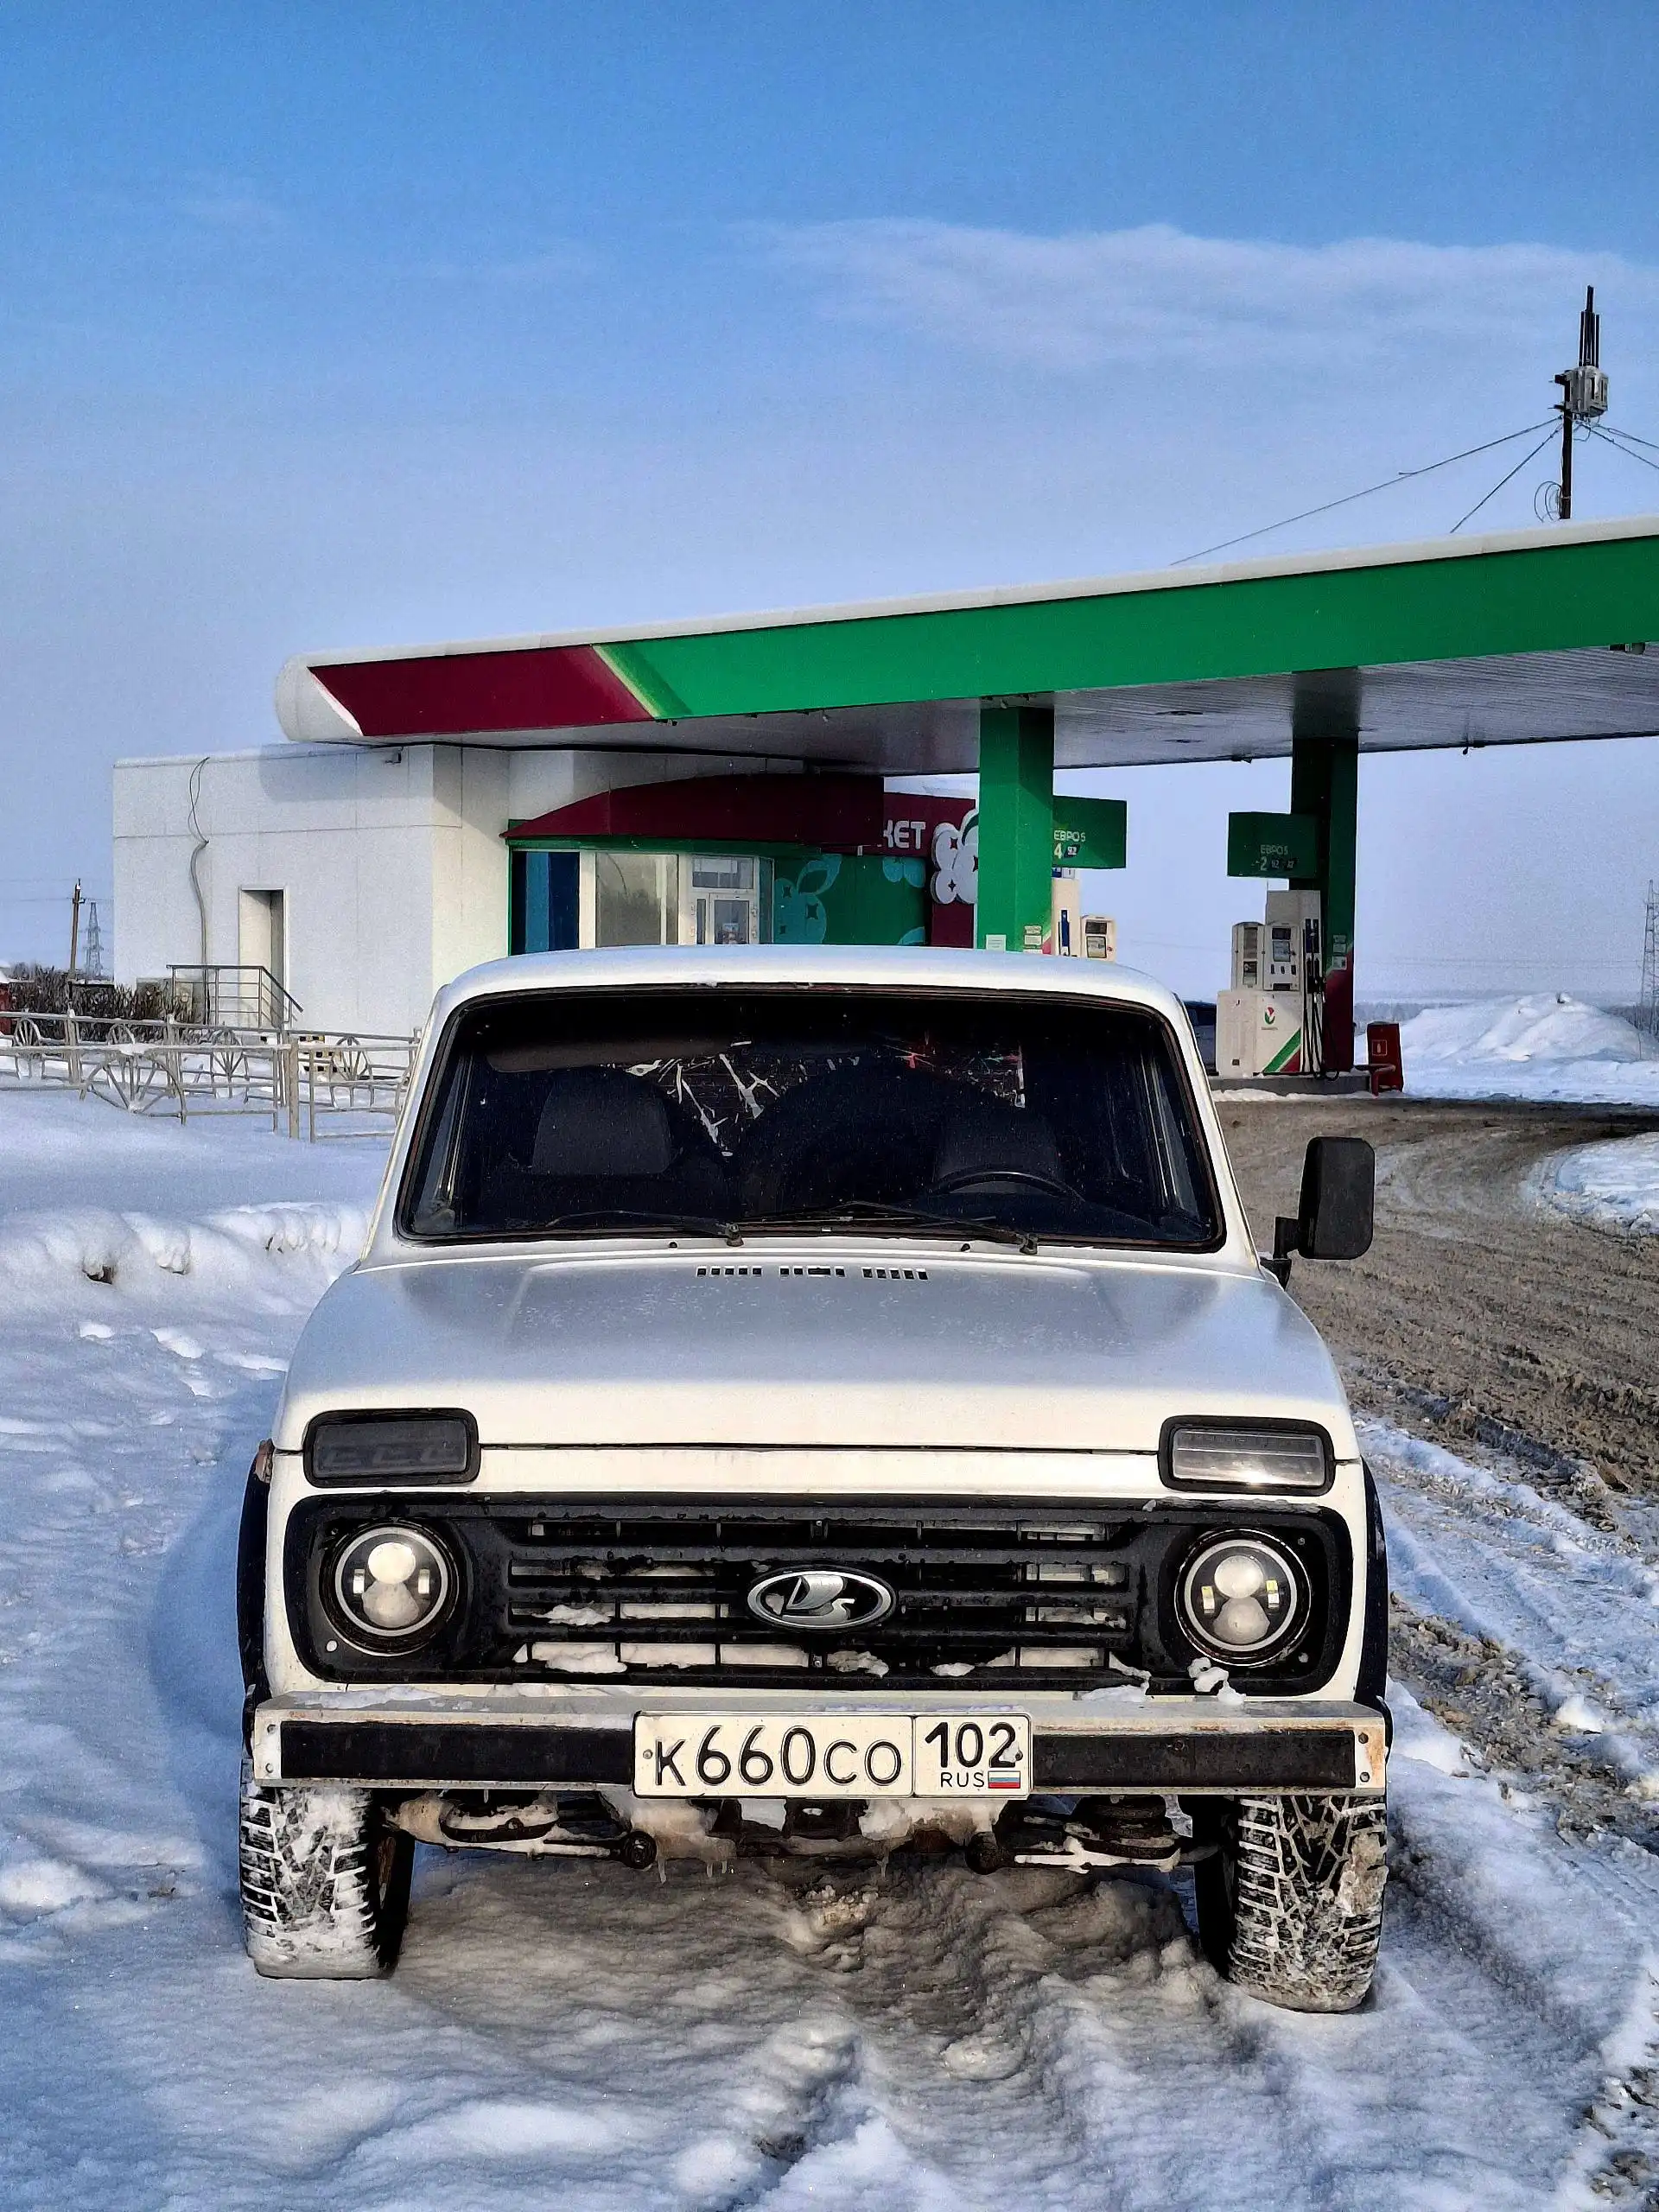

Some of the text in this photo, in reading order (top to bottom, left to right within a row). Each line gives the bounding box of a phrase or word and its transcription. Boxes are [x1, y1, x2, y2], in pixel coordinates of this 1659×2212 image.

[1054, 843, 1062, 859] 4
[1261, 856, 1267, 871] 2
[925, 1721, 1017, 1768] 102
[941, 1771, 984, 1788] RUS
